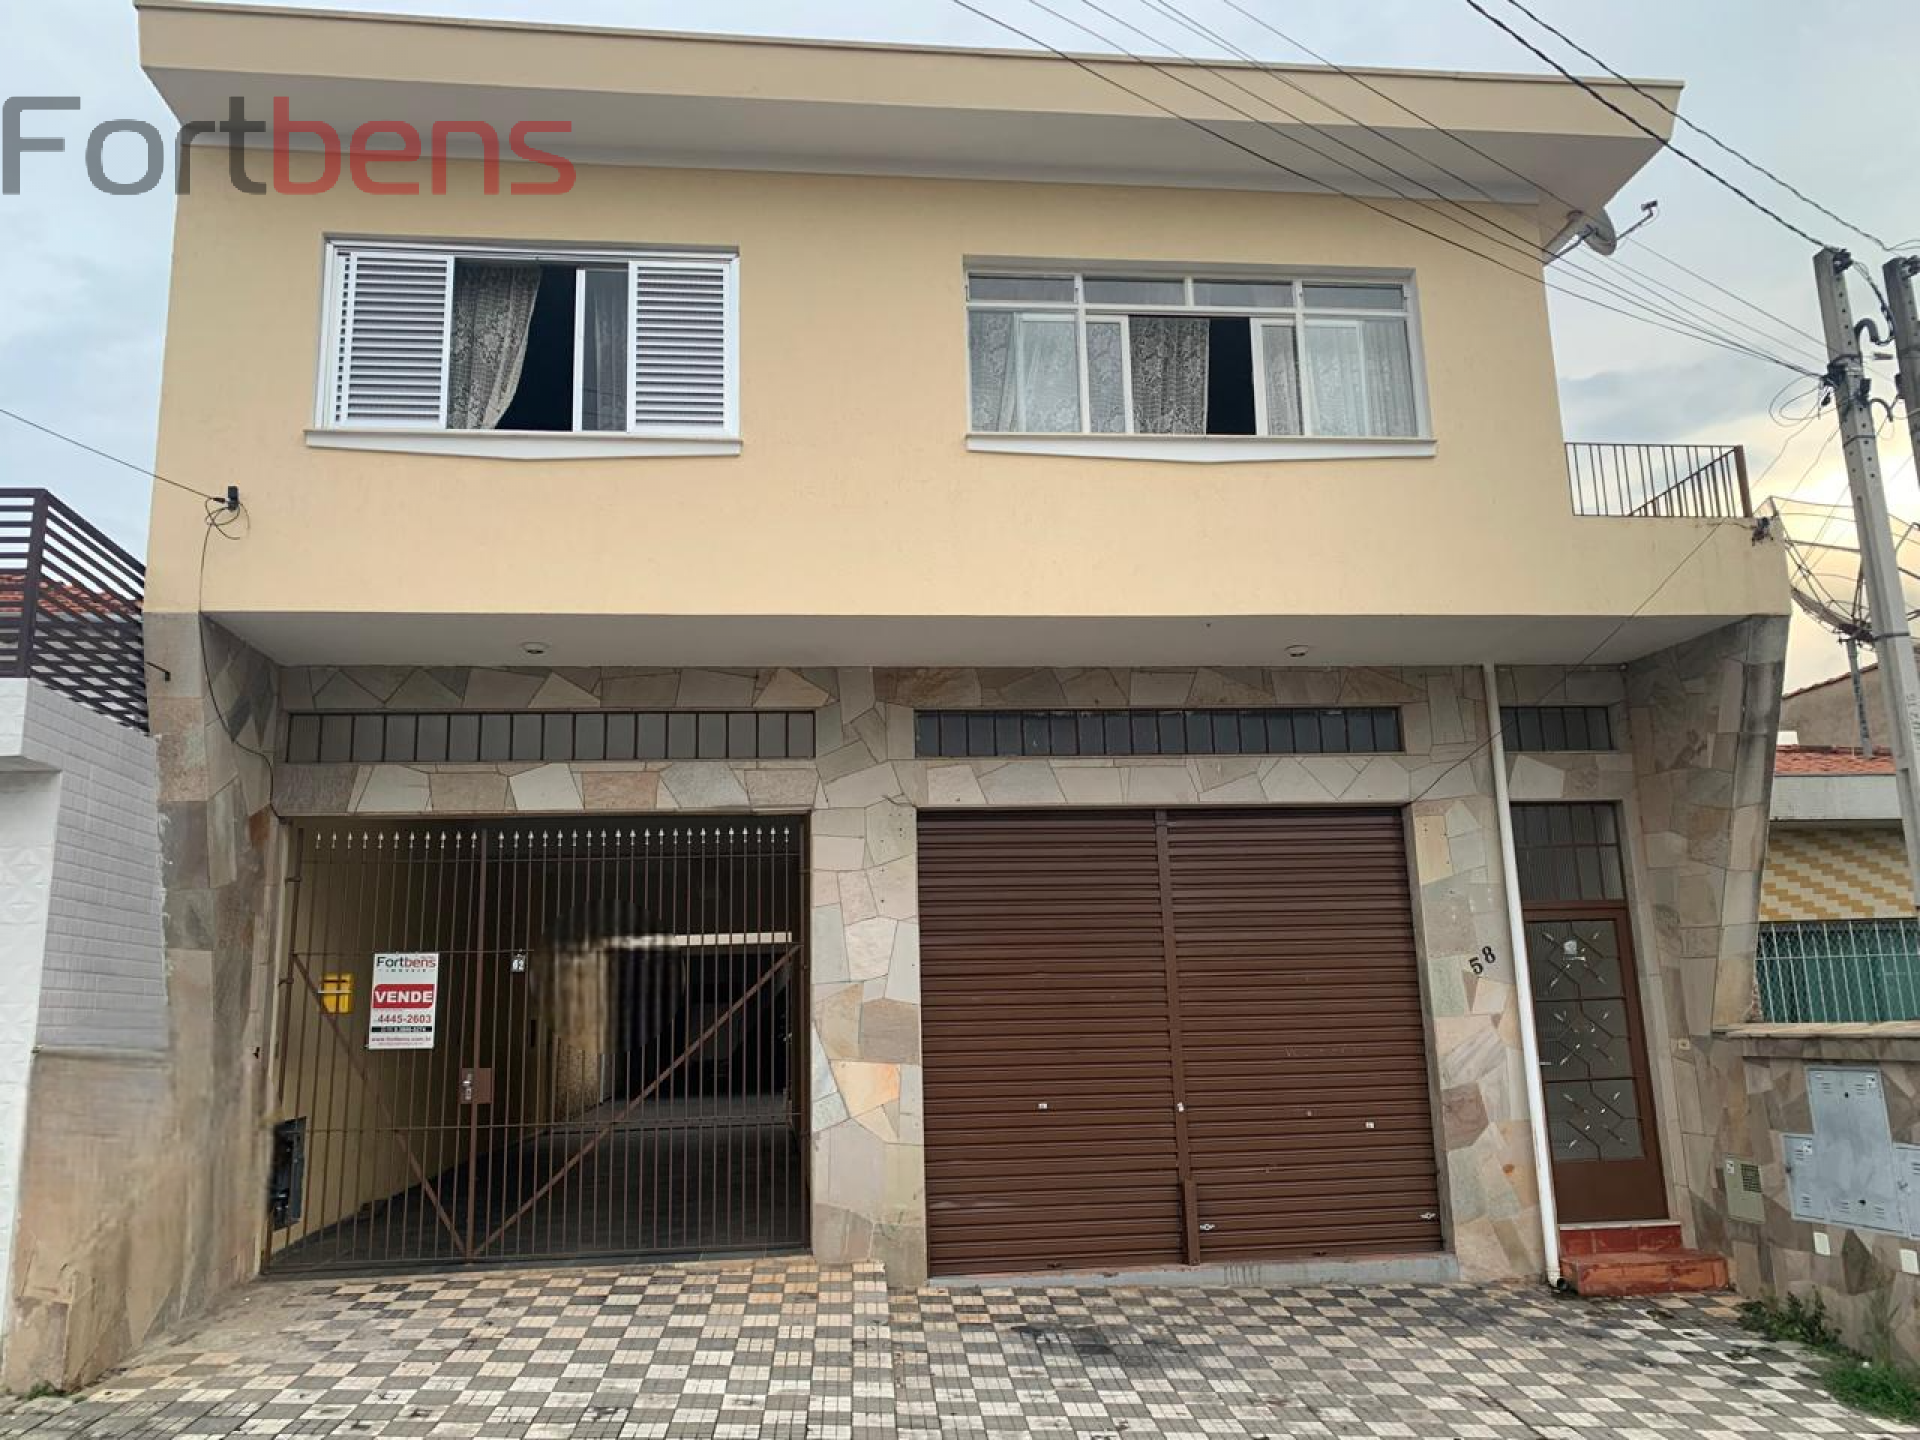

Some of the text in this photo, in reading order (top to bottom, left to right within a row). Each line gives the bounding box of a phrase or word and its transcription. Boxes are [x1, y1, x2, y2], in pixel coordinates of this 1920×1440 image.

[376, 957, 437, 968] Fortbens
[1468, 946, 1496, 974] 58
[374, 990, 433, 1003] VENDE
[377, 1013, 432, 1024] 4445-2603
